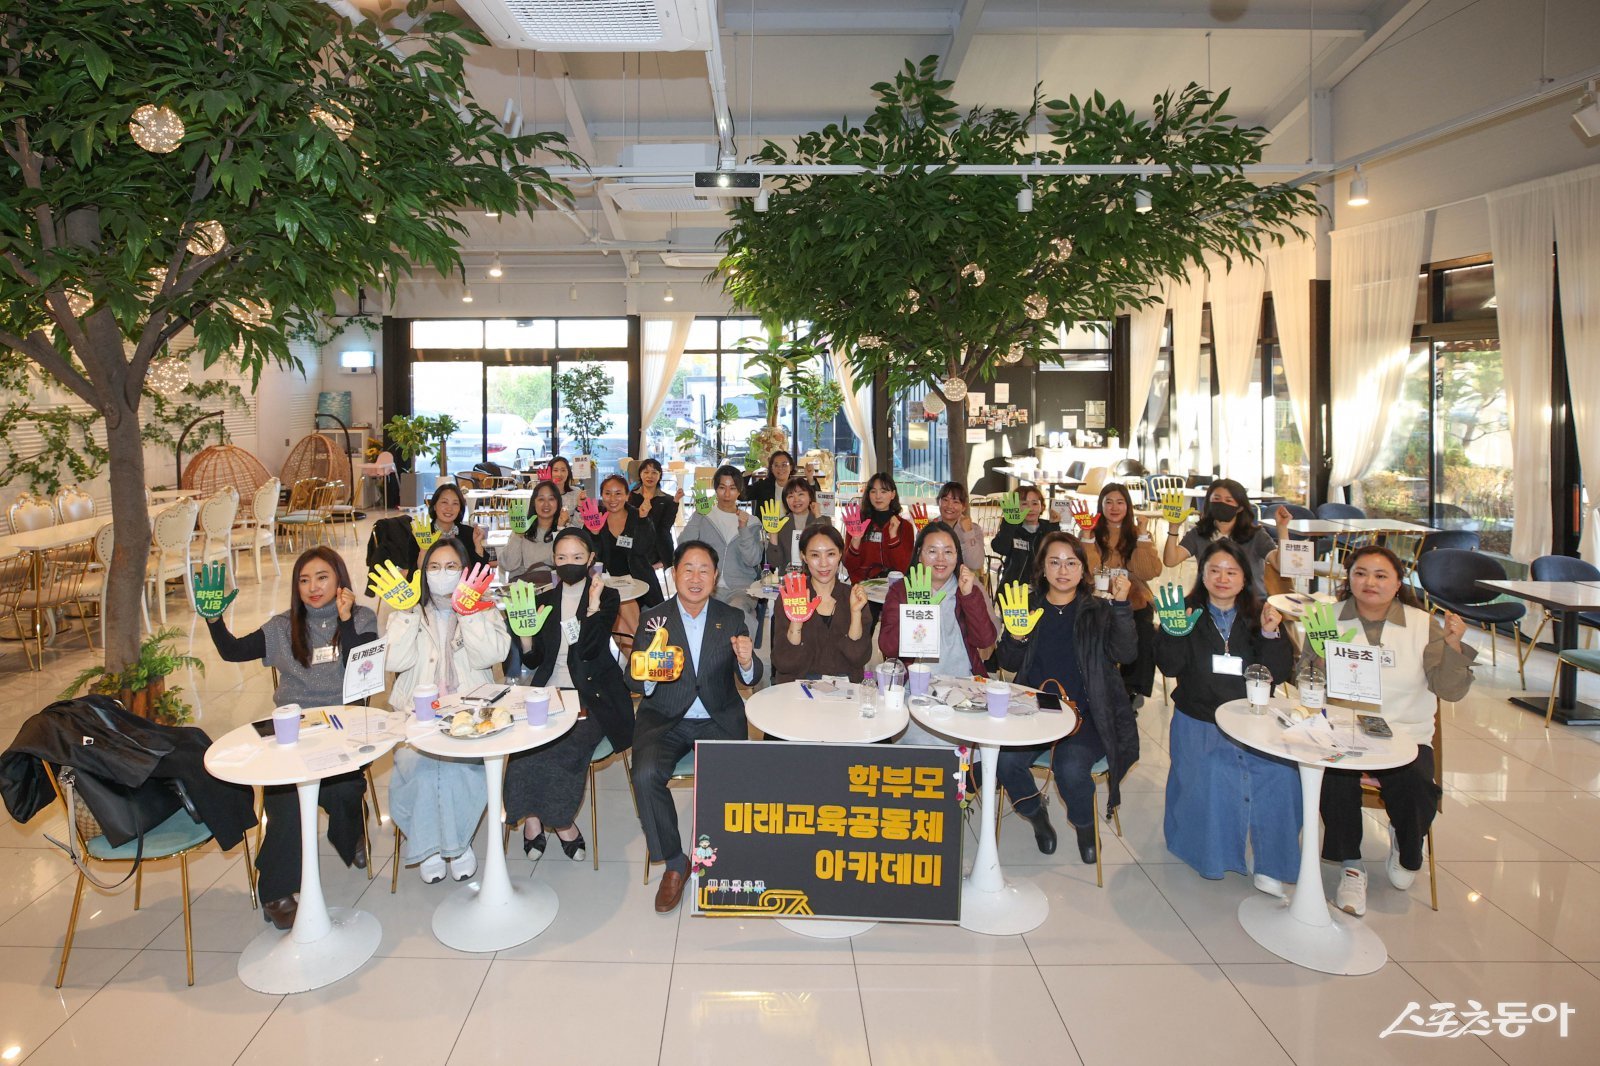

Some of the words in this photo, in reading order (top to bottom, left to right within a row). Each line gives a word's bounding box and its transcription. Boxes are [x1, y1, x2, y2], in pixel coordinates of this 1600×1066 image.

[196, 590, 223, 600] 학부모
[383, 580, 408, 600] 학부모
[457, 583, 481, 601] 학부모
[397, 588, 414, 603] 시장
[908, 591, 930, 600] 학부모
[203, 600, 222, 609] 시장
[458, 596, 475, 609] 시장
[784, 598, 807, 606] 학부모
[509, 608, 536, 619] 학부모
[792, 606, 807, 615] 시장
[906, 609, 934, 620] 덕송초
[1004, 609, 1028, 618] 학부모
[1159, 609, 1185, 619] 학부모
[519, 619, 536, 629] 시장
[1012, 618, 1028, 627] 시장
[1169, 619, 1187, 629] 시장
[1309, 630, 1339, 640] 학부모
[352, 644, 385, 662] 퇴계원초
[1334, 647, 1373, 661] 사능초
[649, 669, 674, 679] 화이팅
[848, 765, 945, 799] 학부모
[724, 802, 944, 843] 미래교육공동체
[815, 849, 942, 887] 아카데미
